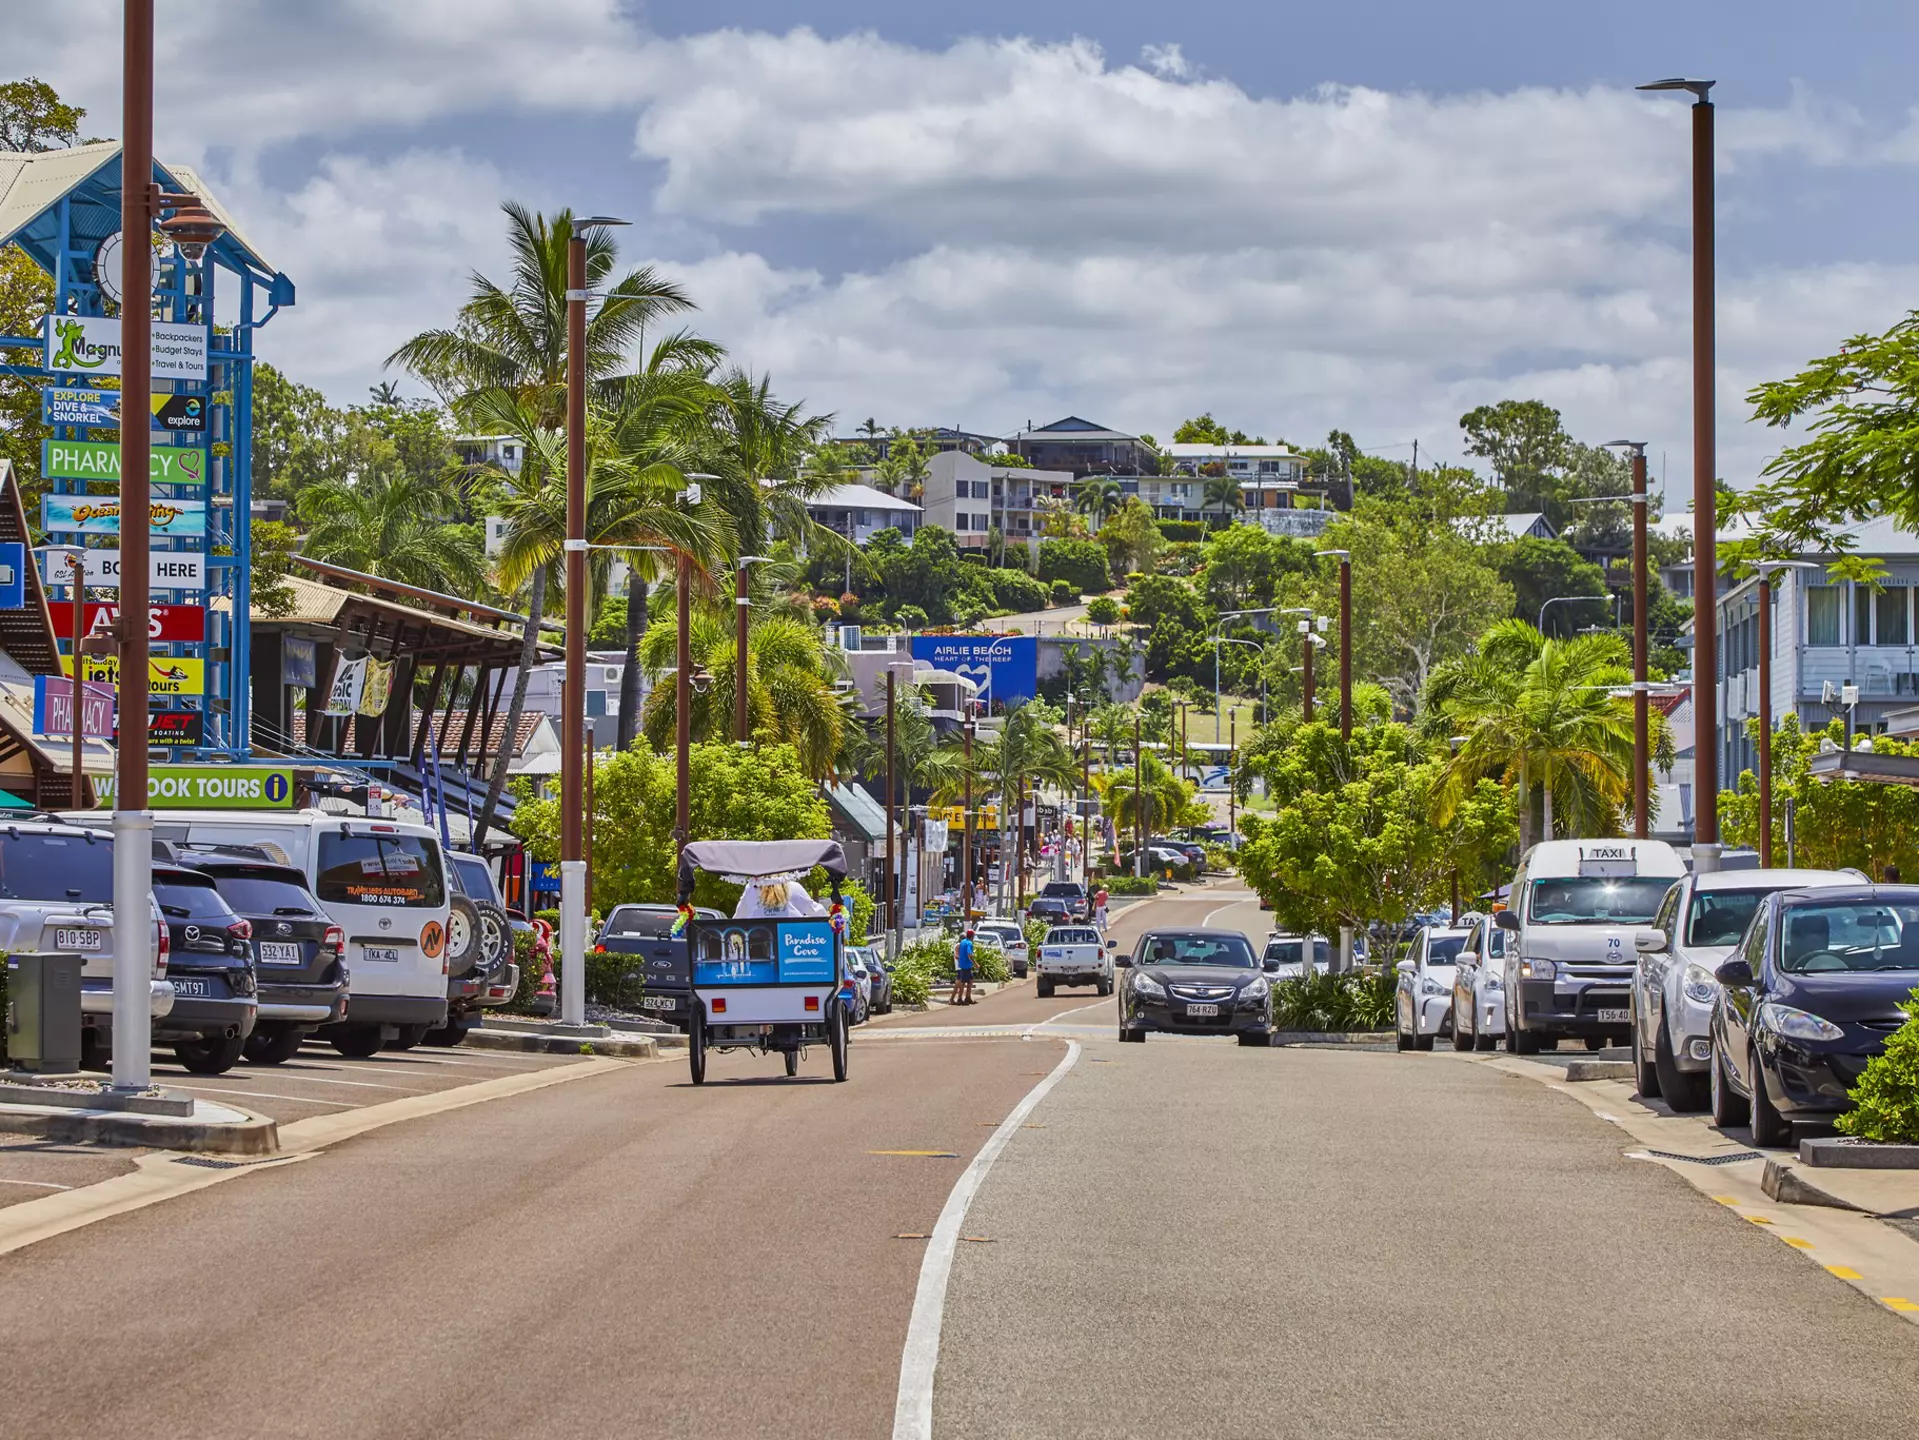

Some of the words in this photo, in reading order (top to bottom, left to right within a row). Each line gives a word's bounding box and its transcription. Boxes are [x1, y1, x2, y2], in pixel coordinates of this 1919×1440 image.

[155, 331, 203, 343] Backpackers
[155, 344, 182, 356] Budget
[184, 346, 203, 356] Stays
[155, 360, 177, 369] Travel
[179, 361, 184, 369] &
[185, 361, 204, 371] Tours
[53, 391, 101, 403] EXPLORE
[53, 402, 78, 413] DIVE
[80, 403, 87, 413] &
[53, 412, 102, 424] SNORKEL
[167, 415, 201, 427] explore
[52, 448, 173, 476] PHARMCY
[157, 562, 197, 578] HERE
[934, 646, 970, 655] AIRLIE
[972, 646, 1012, 655] BEACH
[147, 777, 191, 798] OOK
[196, 777, 261, 798] TOURS
[1595, 849, 1622, 858] TAXI
[361, 893, 377, 903] 1800
[379, 894, 392, 904] 674
[393, 895, 405, 904] 374
[784, 933, 827, 946] Paradise
[1607, 938, 1620, 948] 70
[793, 945, 819, 956] Cove
